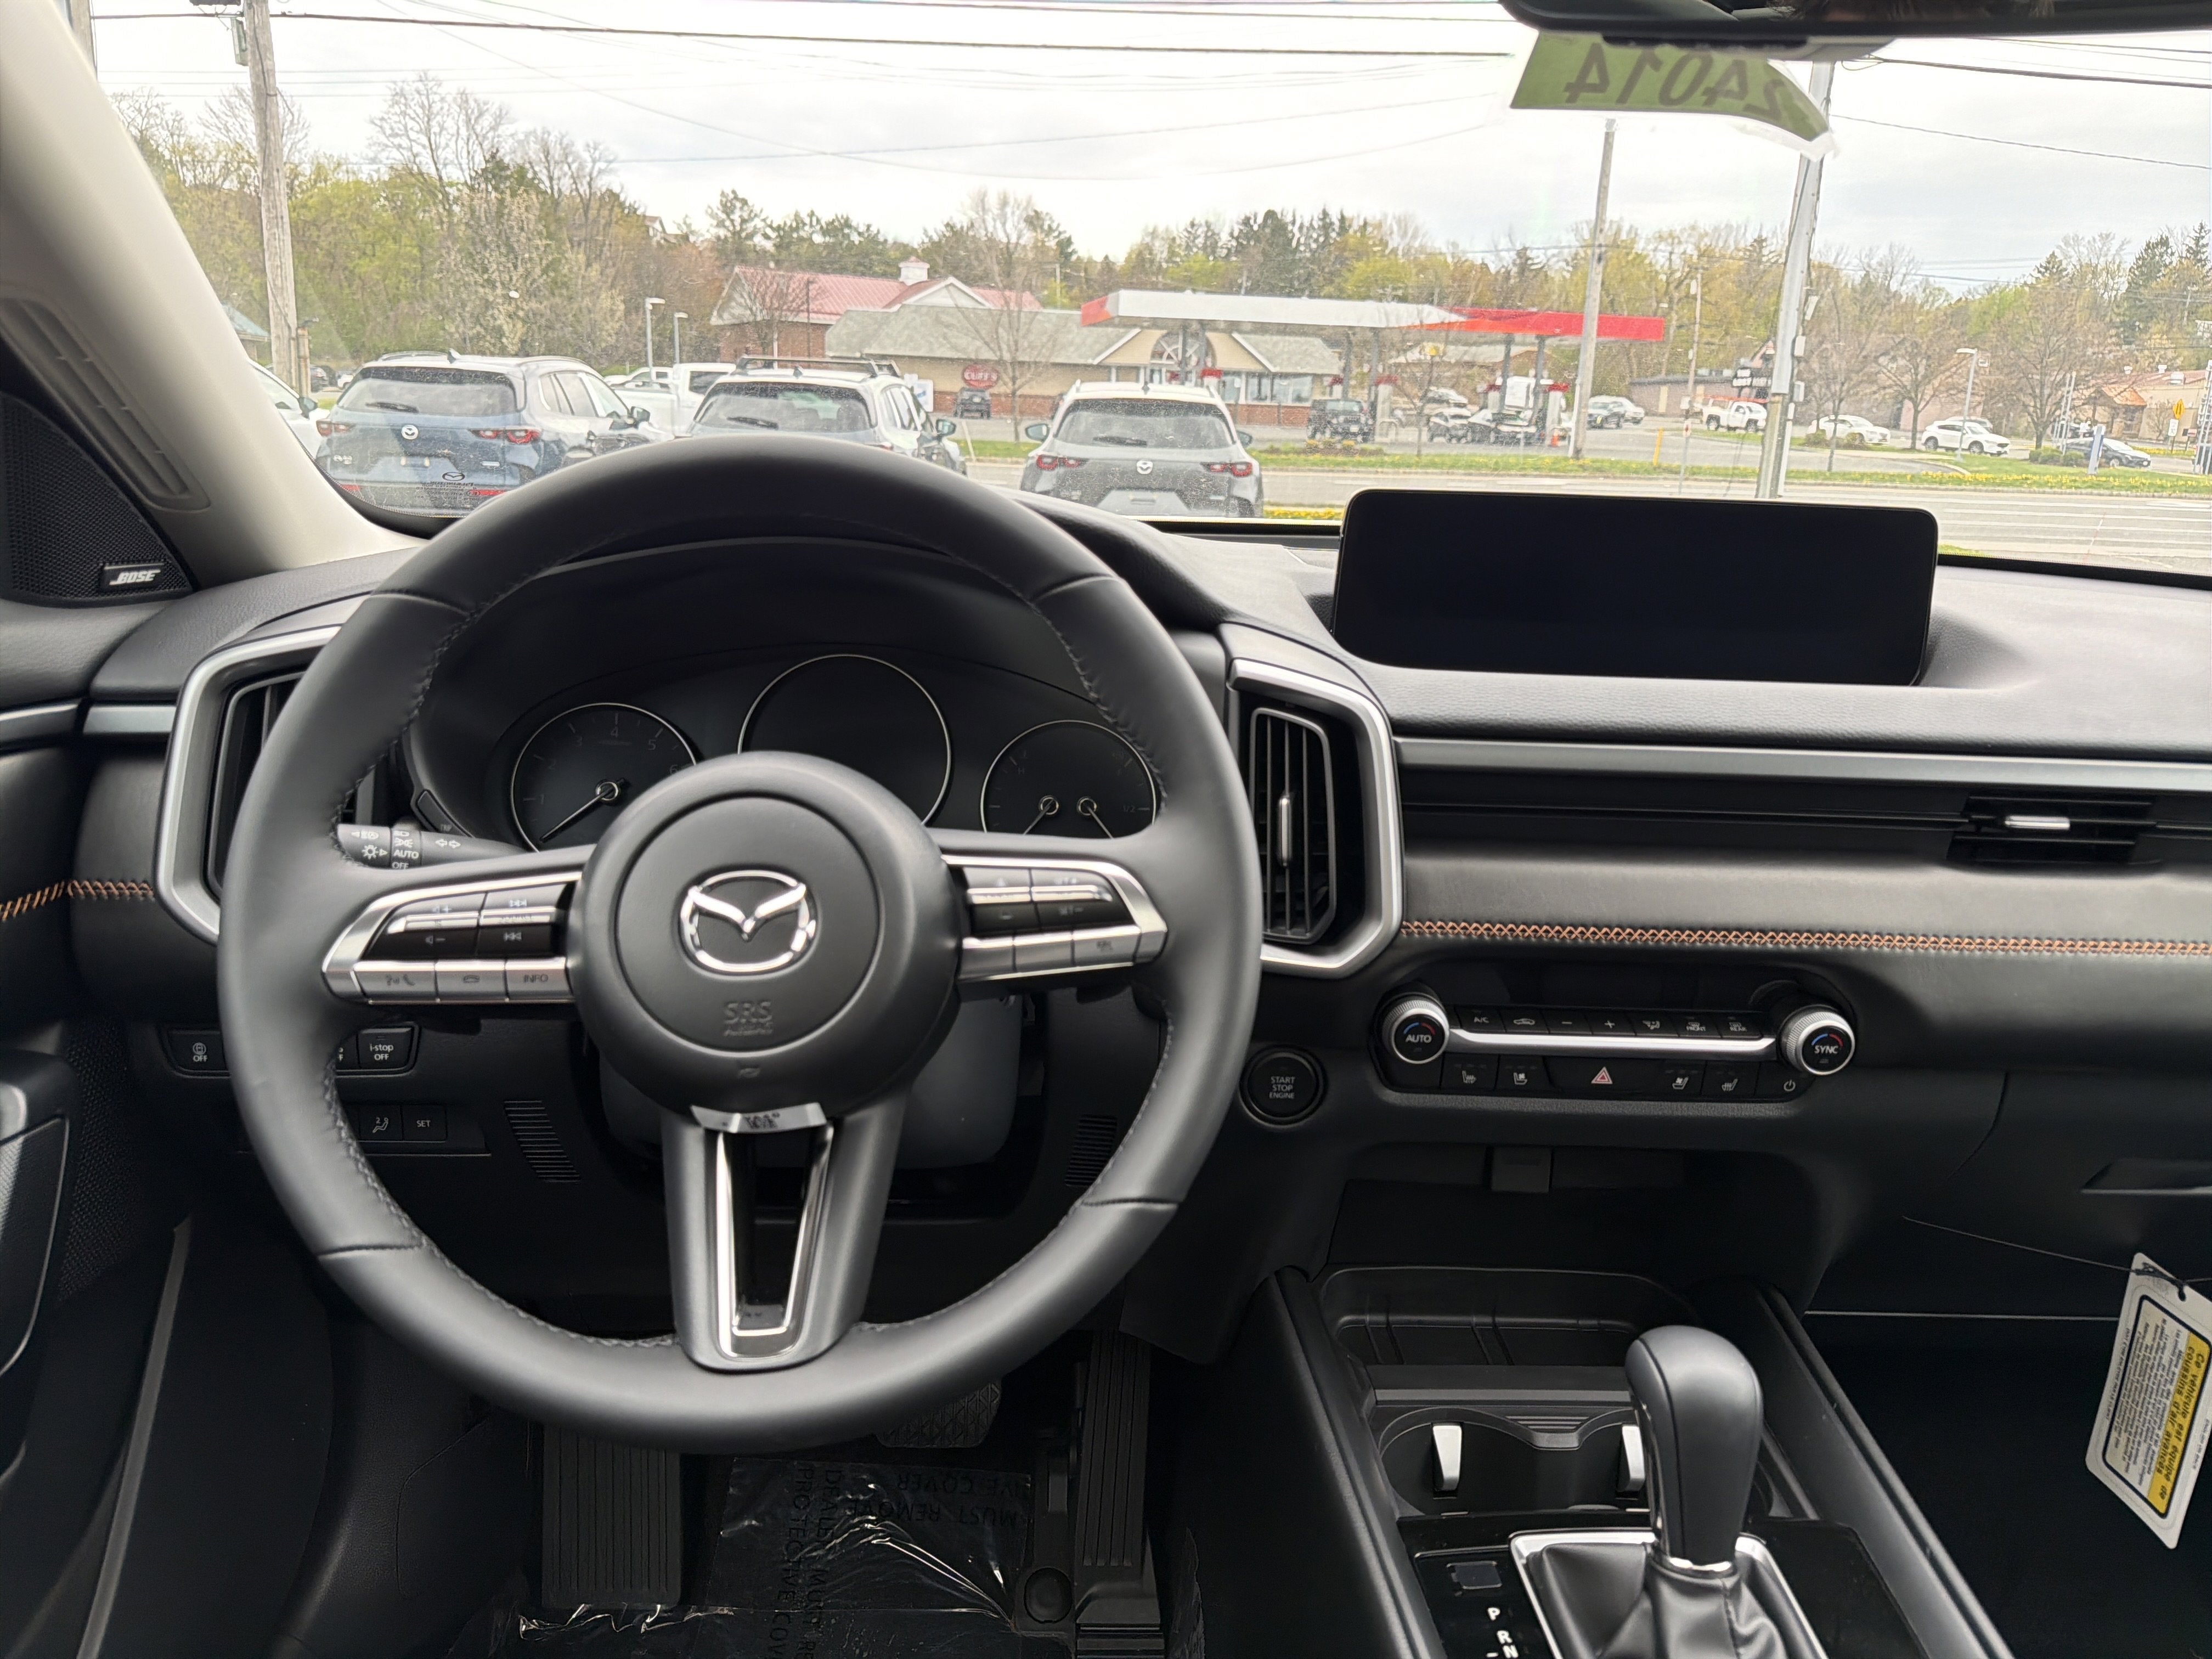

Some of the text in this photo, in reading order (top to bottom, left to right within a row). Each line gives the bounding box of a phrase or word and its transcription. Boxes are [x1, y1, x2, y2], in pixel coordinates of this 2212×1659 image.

[109, 569, 161, 585] BOSE
[393, 850, 419, 859] AUTO
[524, 974, 548, 983] INFO
[723, 1001, 772, 1024] SRS
[1406, 1034, 1432, 1043] AUTO
[369, 1043, 394, 1054] i-stop
[1814, 1045, 1838, 1054] SYNC
[1271, 1076, 1295, 1084] START
[2194, 1352, 2205, 1369] Ce
[2176, 1346, 2194, 1396] coussins
[2180, 1373, 2198, 1419] véhicule
[2168, 1400, 2181, 1427] d'air
[2174, 1423, 2184, 1442] est
[2159, 1485, 2167, 1500] de
[1487, 1607, 1500, 1621] P
[1497, 1630, 1513, 1644] R
[1502, 1644, 1519, 1658] N
